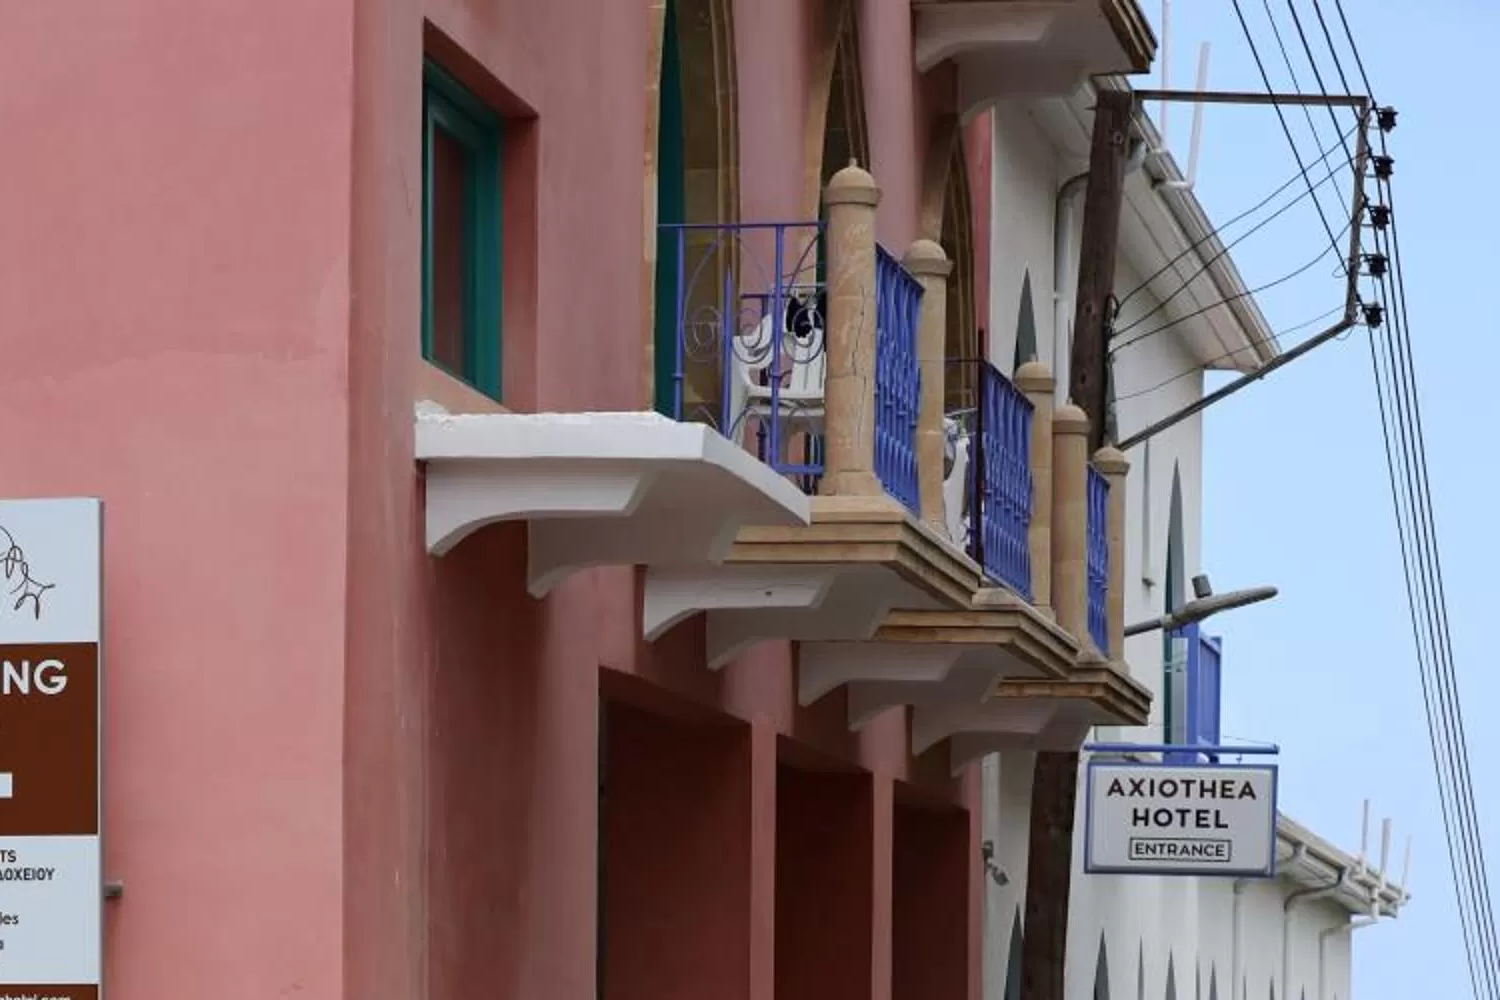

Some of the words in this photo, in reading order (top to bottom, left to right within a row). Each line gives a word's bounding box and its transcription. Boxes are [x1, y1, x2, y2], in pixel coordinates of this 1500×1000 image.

[1107, 777, 1257, 800] AXIOTHEA
[1132, 808, 1229, 829] HOTEL
[1135, 842, 1225, 857] ENTRANCE
